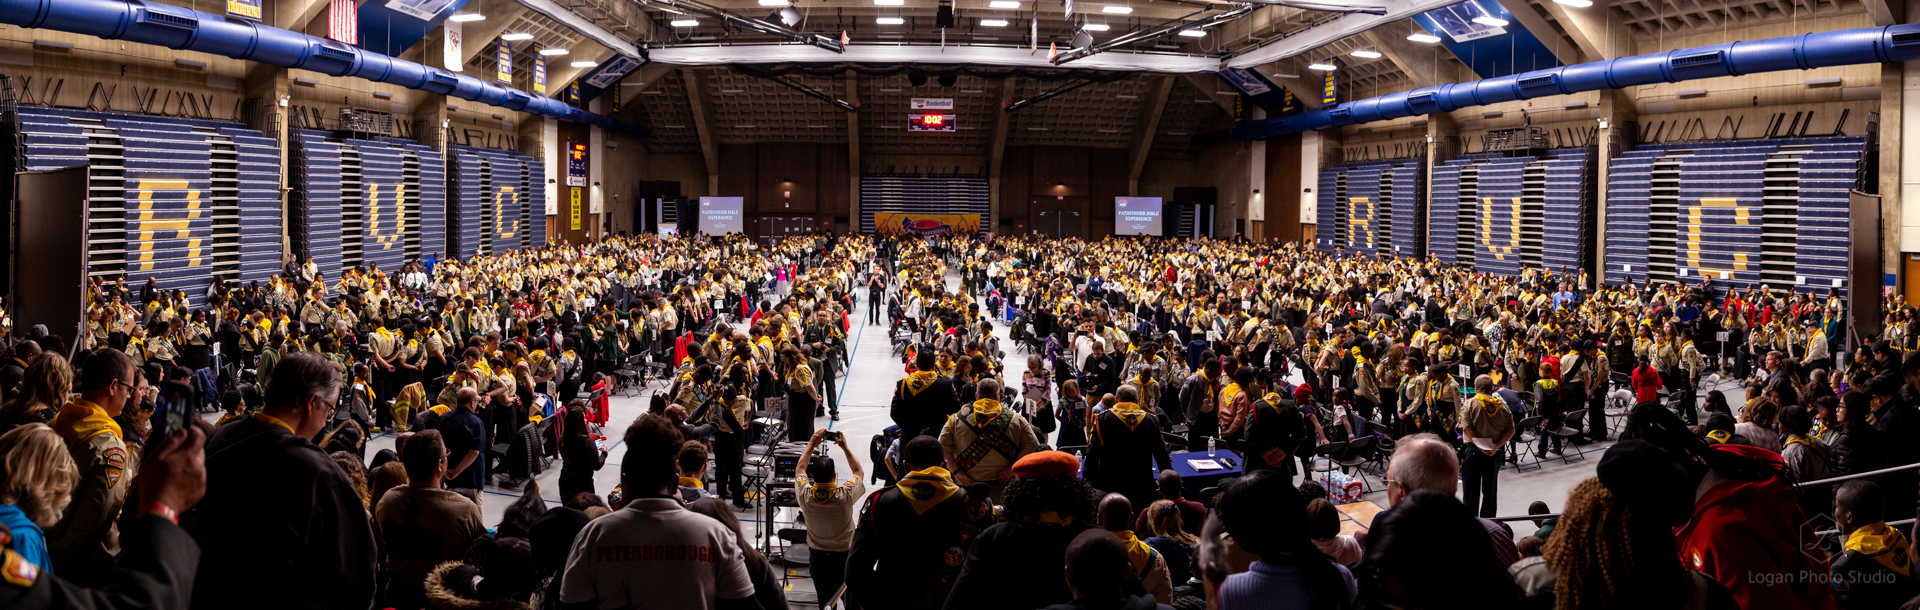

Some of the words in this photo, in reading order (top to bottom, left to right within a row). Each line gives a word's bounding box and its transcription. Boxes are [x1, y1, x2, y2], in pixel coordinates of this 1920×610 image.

[400, 5, 423, 15] SOFTBALL
[1467, 31, 1490, 39] BOWLING
[121, 64, 126, 76] F
[137, 179, 202, 271] R
[1348, 196, 1375, 247] R
[547, 382, 554, 391] 89
[766, 399, 781, 408] 195
[596, 544, 716, 563] PETERBOROUGH
